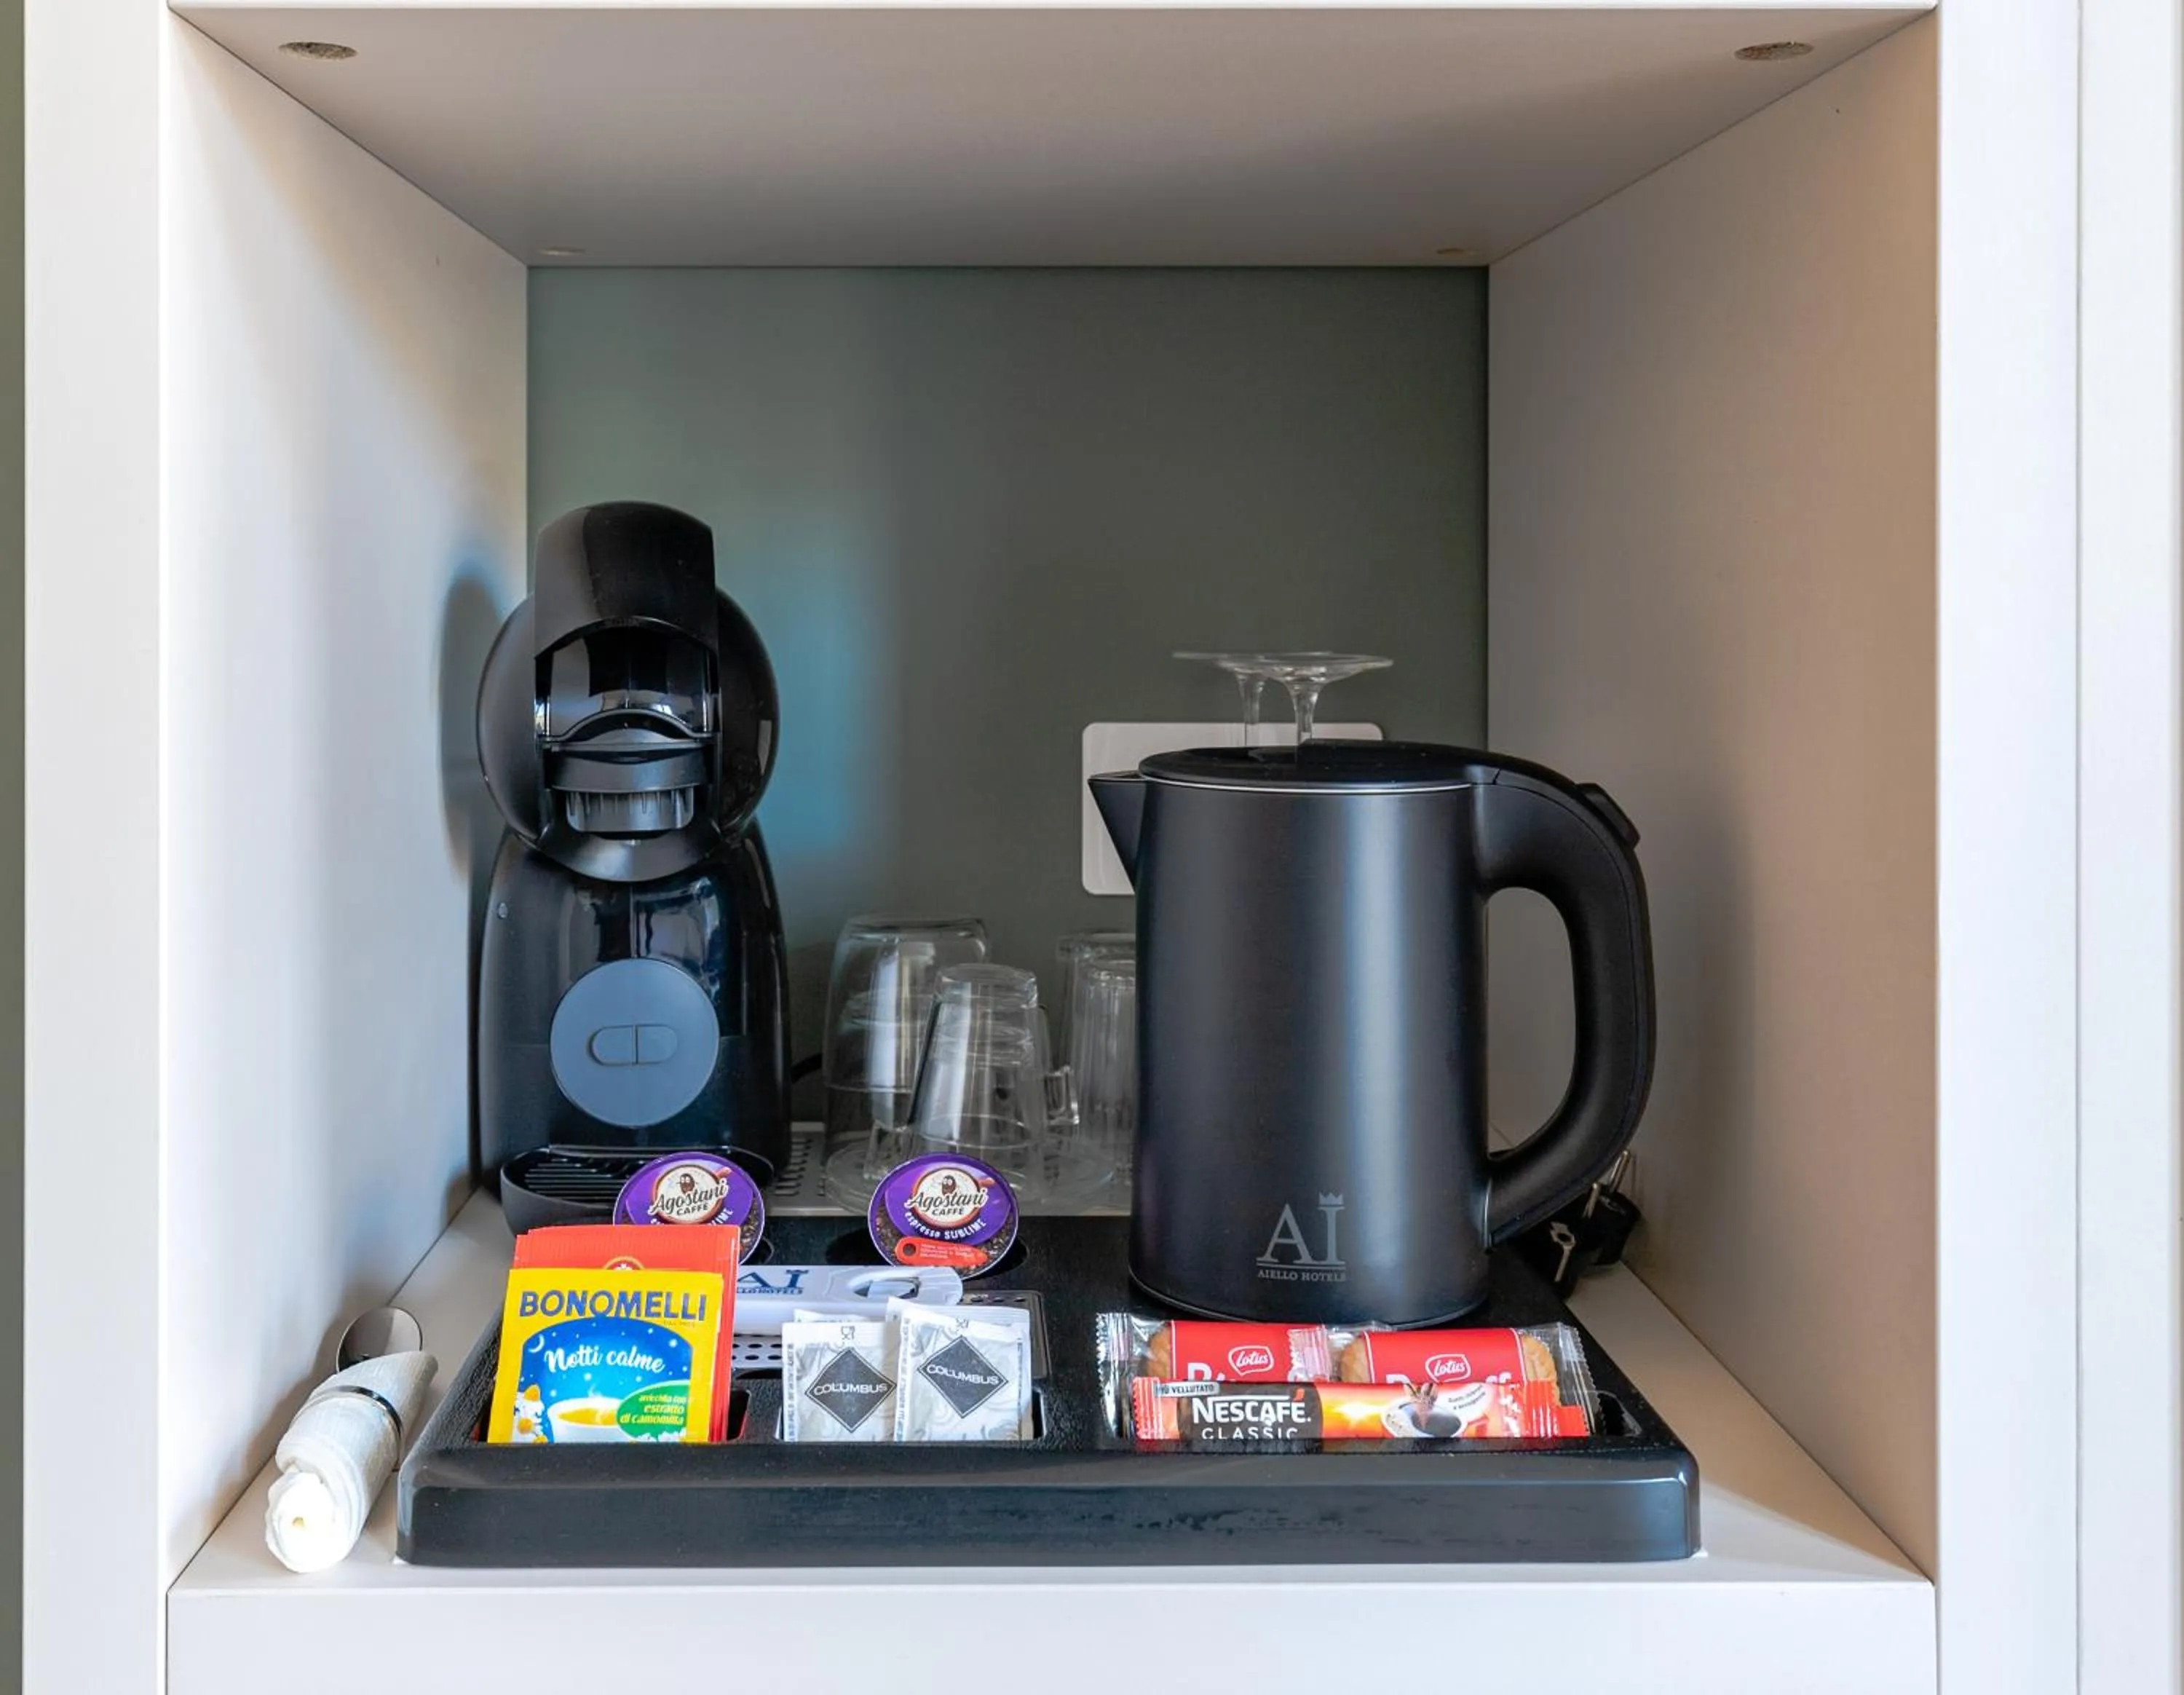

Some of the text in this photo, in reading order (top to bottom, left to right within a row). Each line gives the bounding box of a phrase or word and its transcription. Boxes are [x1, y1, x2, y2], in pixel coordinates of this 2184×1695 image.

[649, 1178, 729, 1214] Agostani
[905, 1187, 989, 1212] Agostani
[905, 1212, 986, 1240] espresso SUBLIME
[1256, 1203, 1346, 1265] AI
[1257, 1269, 1346, 1281] AIELLO HOTELS
[519, 1290, 707, 1321] BONOMELLI
[545, 1344, 665, 1373] Notti calme
[1237, 1350, 1269, 1367] Lotus
[1433, 1359, 1465, 1377] Lotus
[927, 1364, 1000, 1386] COLUMBUS
[813, 1382, 888, 1396] COLUMBUS
[1171, 1384, 1214, 1394] VELLUTATO
[1202, 1427, 1298, 1439] CLASSIC
